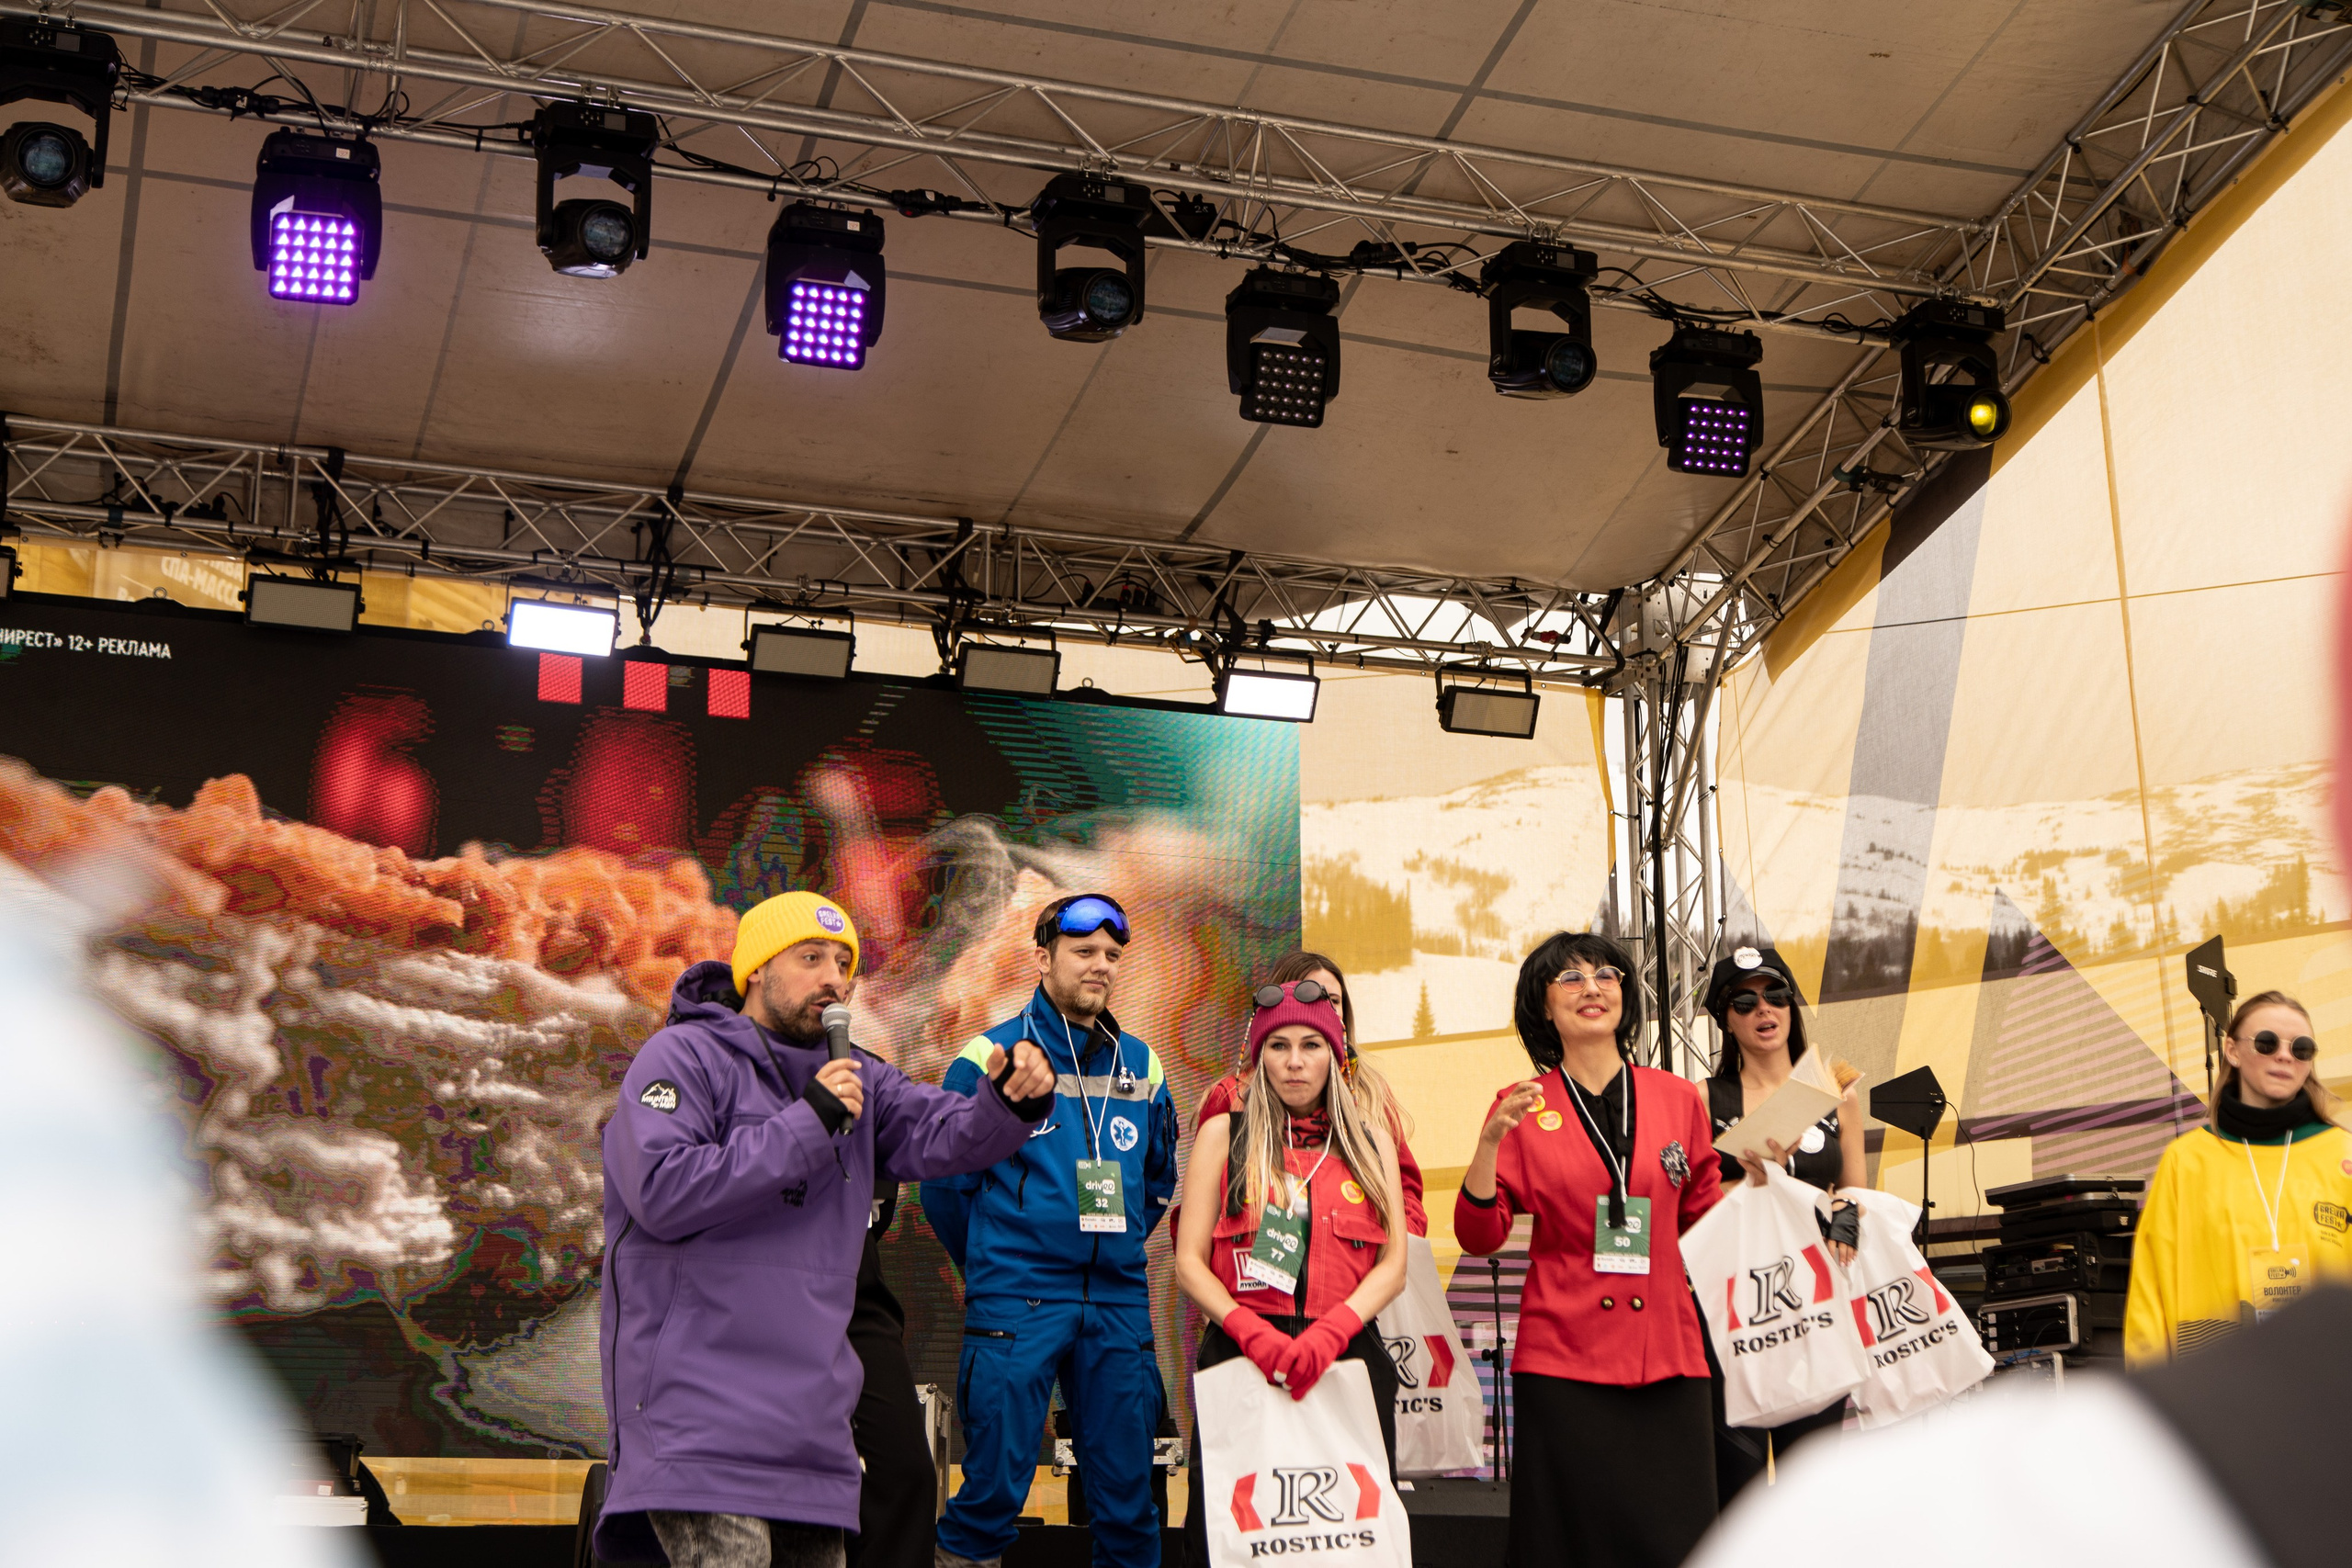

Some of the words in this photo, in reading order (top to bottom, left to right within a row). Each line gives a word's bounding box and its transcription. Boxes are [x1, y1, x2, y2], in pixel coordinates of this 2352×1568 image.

[68, 635, 94, 651] 12+
[97, 637, 172, 659] РЕКЛАМА
[1095, 1198, 1108, 1208] 32
[1614, 1235, 1631, 1247] 50
[1271, 1247, 1285, 1261] 77
[1239, 1280, 1267, 1290] ЛУКОЙЛ
[2264, 1286, 2301, 1296] ВОЛОНТЕР
[1733, 1312, 1834, 1357] ROSTIC'S
[1873, 1320, 1959, 1369] ROSTIC'S
[1250, 1530, 1375, 1559] ROSTIC'S
